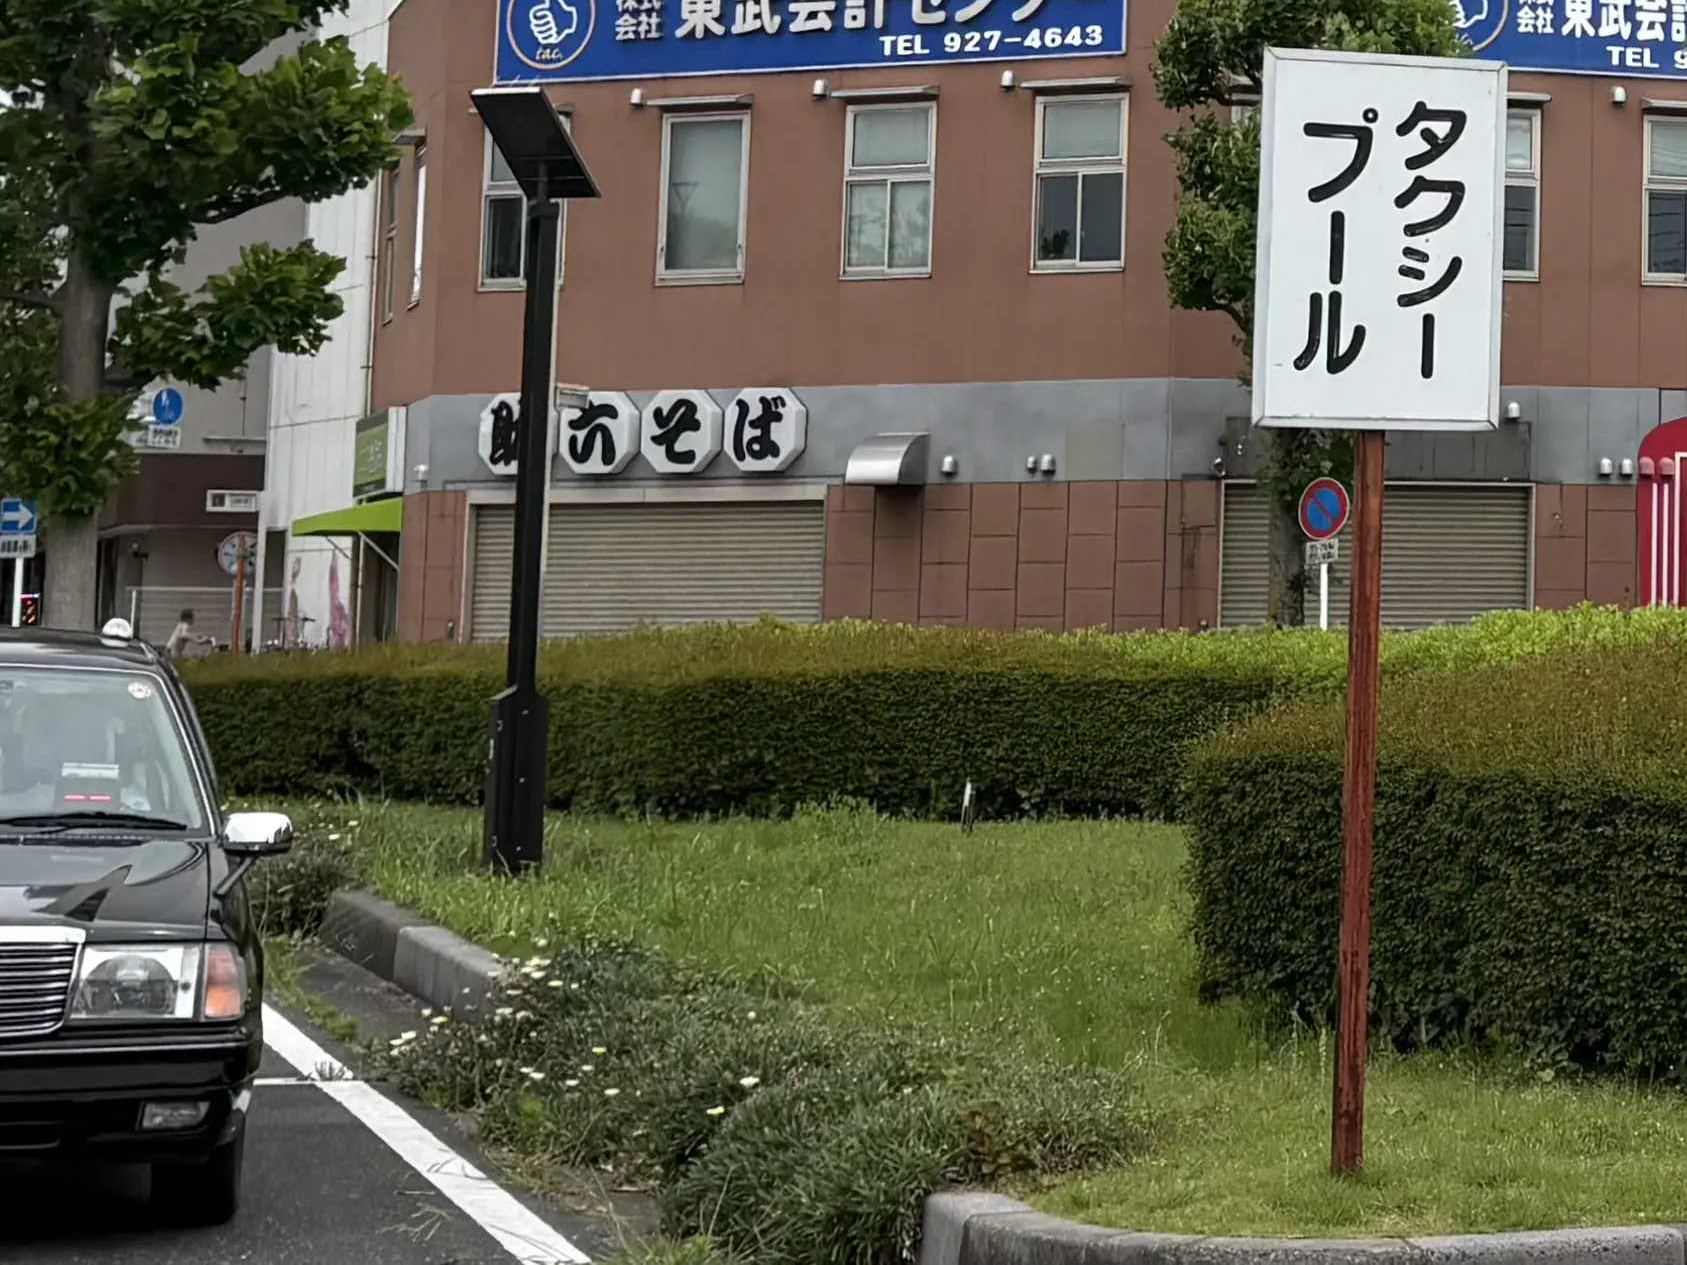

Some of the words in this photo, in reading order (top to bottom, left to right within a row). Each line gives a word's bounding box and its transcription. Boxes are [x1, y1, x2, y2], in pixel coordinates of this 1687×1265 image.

[615, 13, 662, 40] 会社
[1517, 7, 1553, 34] 会社
[880, 35, 930, 56] TEL
[944, 25, 1103, 54] 927-4643
[1607, 46, 1659, 68] TEL
[1293, 108, 1378, 374] プール
[1394, 101, 1467, 379] タクシー
